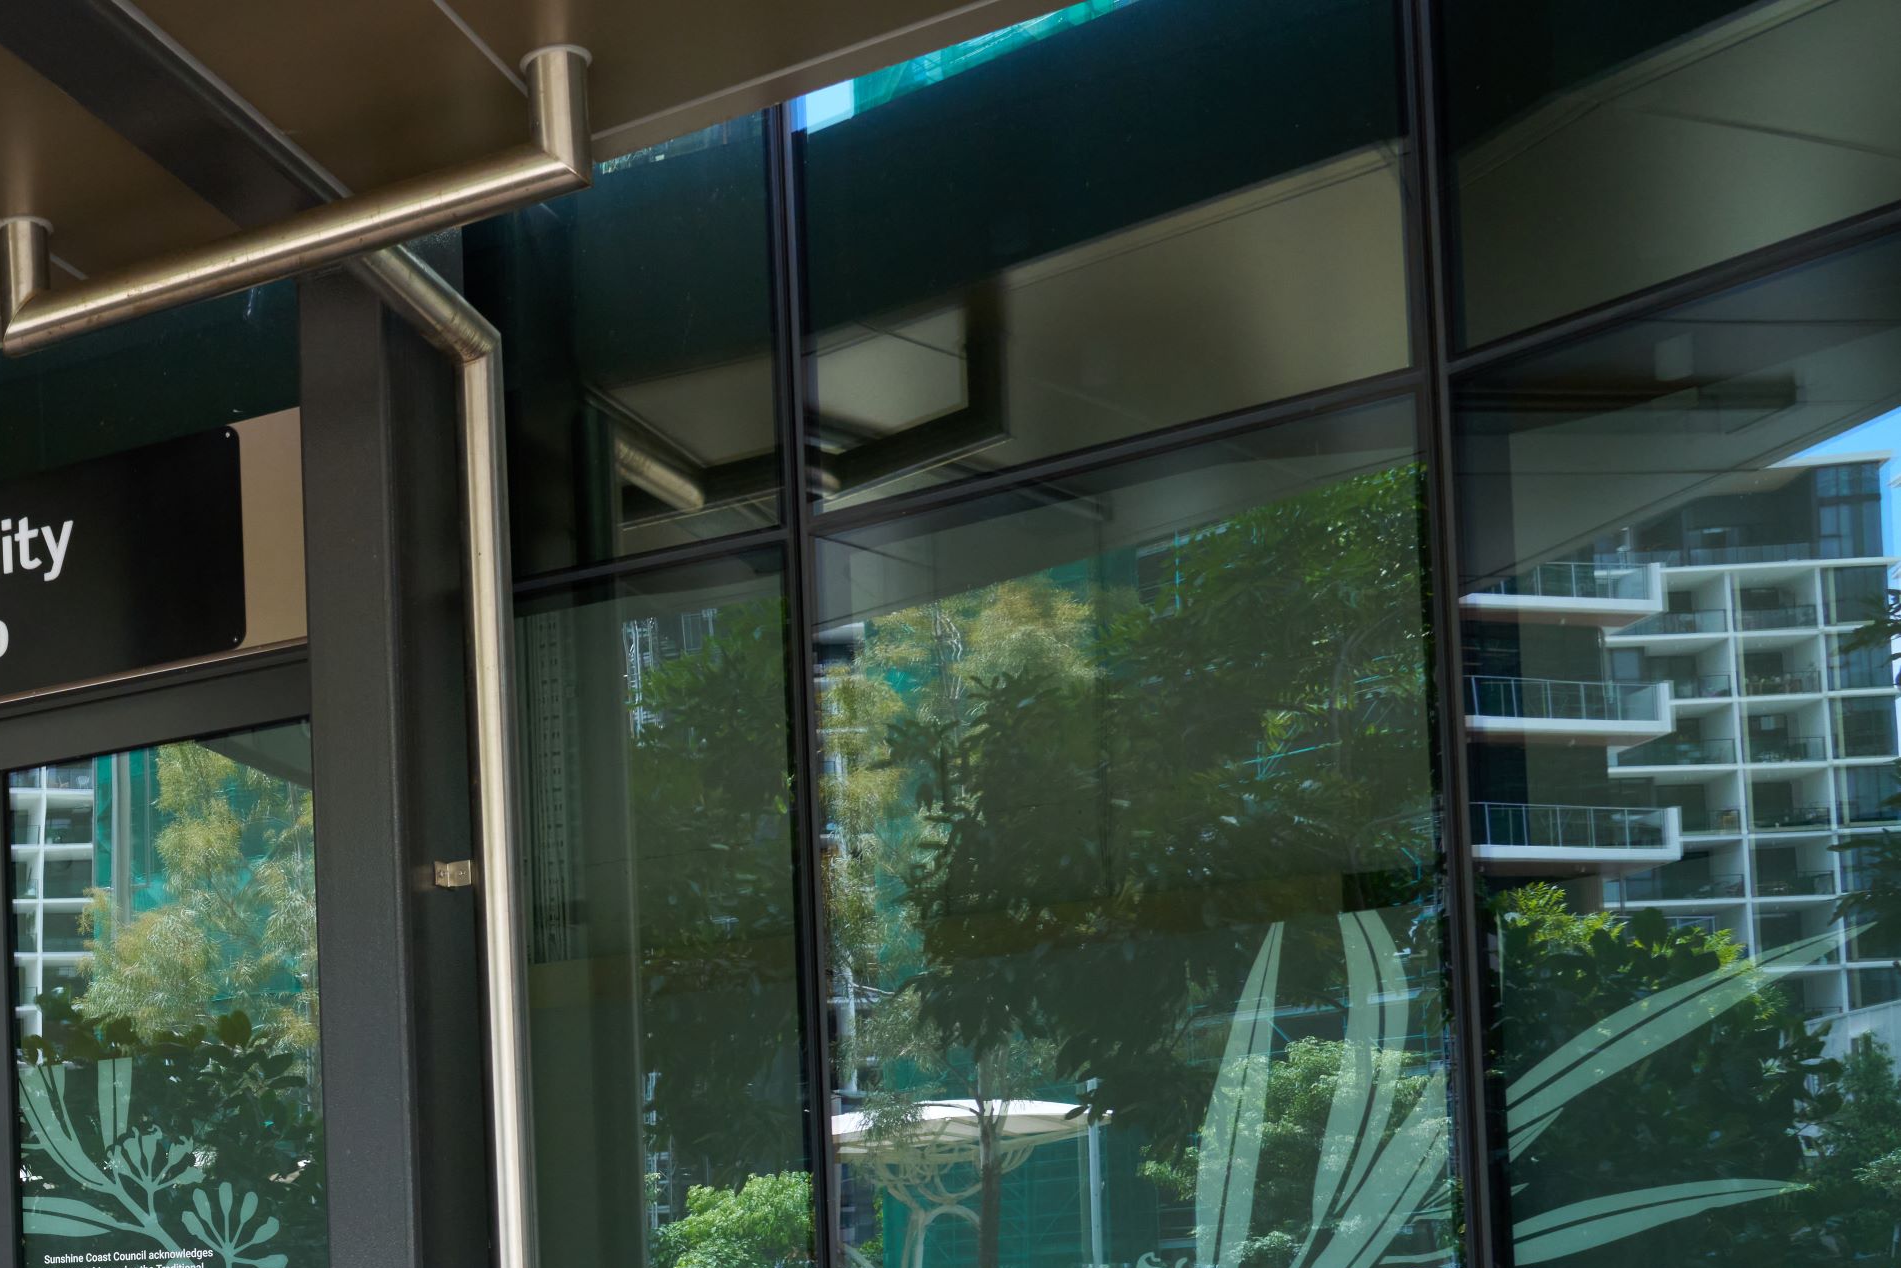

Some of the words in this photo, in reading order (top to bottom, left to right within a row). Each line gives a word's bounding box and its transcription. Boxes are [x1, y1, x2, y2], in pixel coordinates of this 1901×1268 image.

[44, 1253, 84, 1265] Sunshine
[85, 1252, 111, 1263] Coast
[113, 1250, 147, 1261] Council
[148, 1248, 214, 1260] acknowledges
